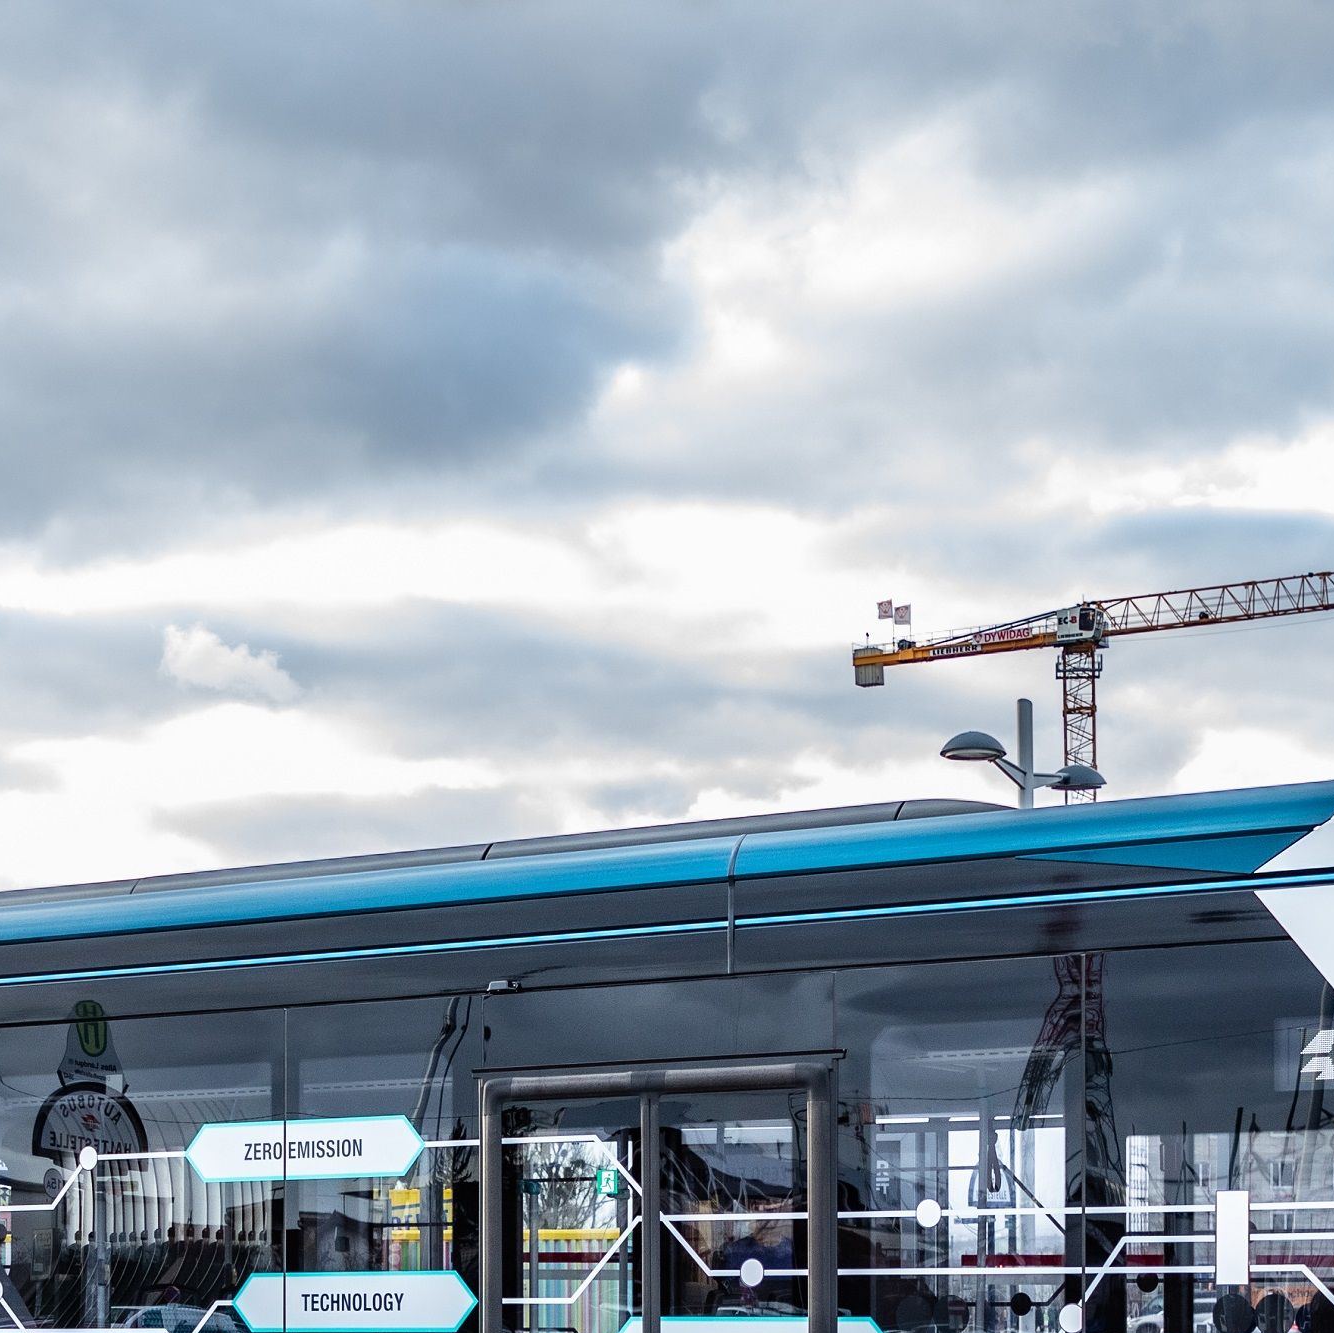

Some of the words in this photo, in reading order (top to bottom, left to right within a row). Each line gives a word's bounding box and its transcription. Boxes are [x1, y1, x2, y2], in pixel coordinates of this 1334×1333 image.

[984, 628, 1030, 643] DYWIDAG
[932, 644, 978, 655] LIEBHERR
[244, 1142, 283, 1161] ZERO
[288, 1138, 363, 1159] EMISSION
[301, 1292, 404, 1312] TECHNOLOGY
